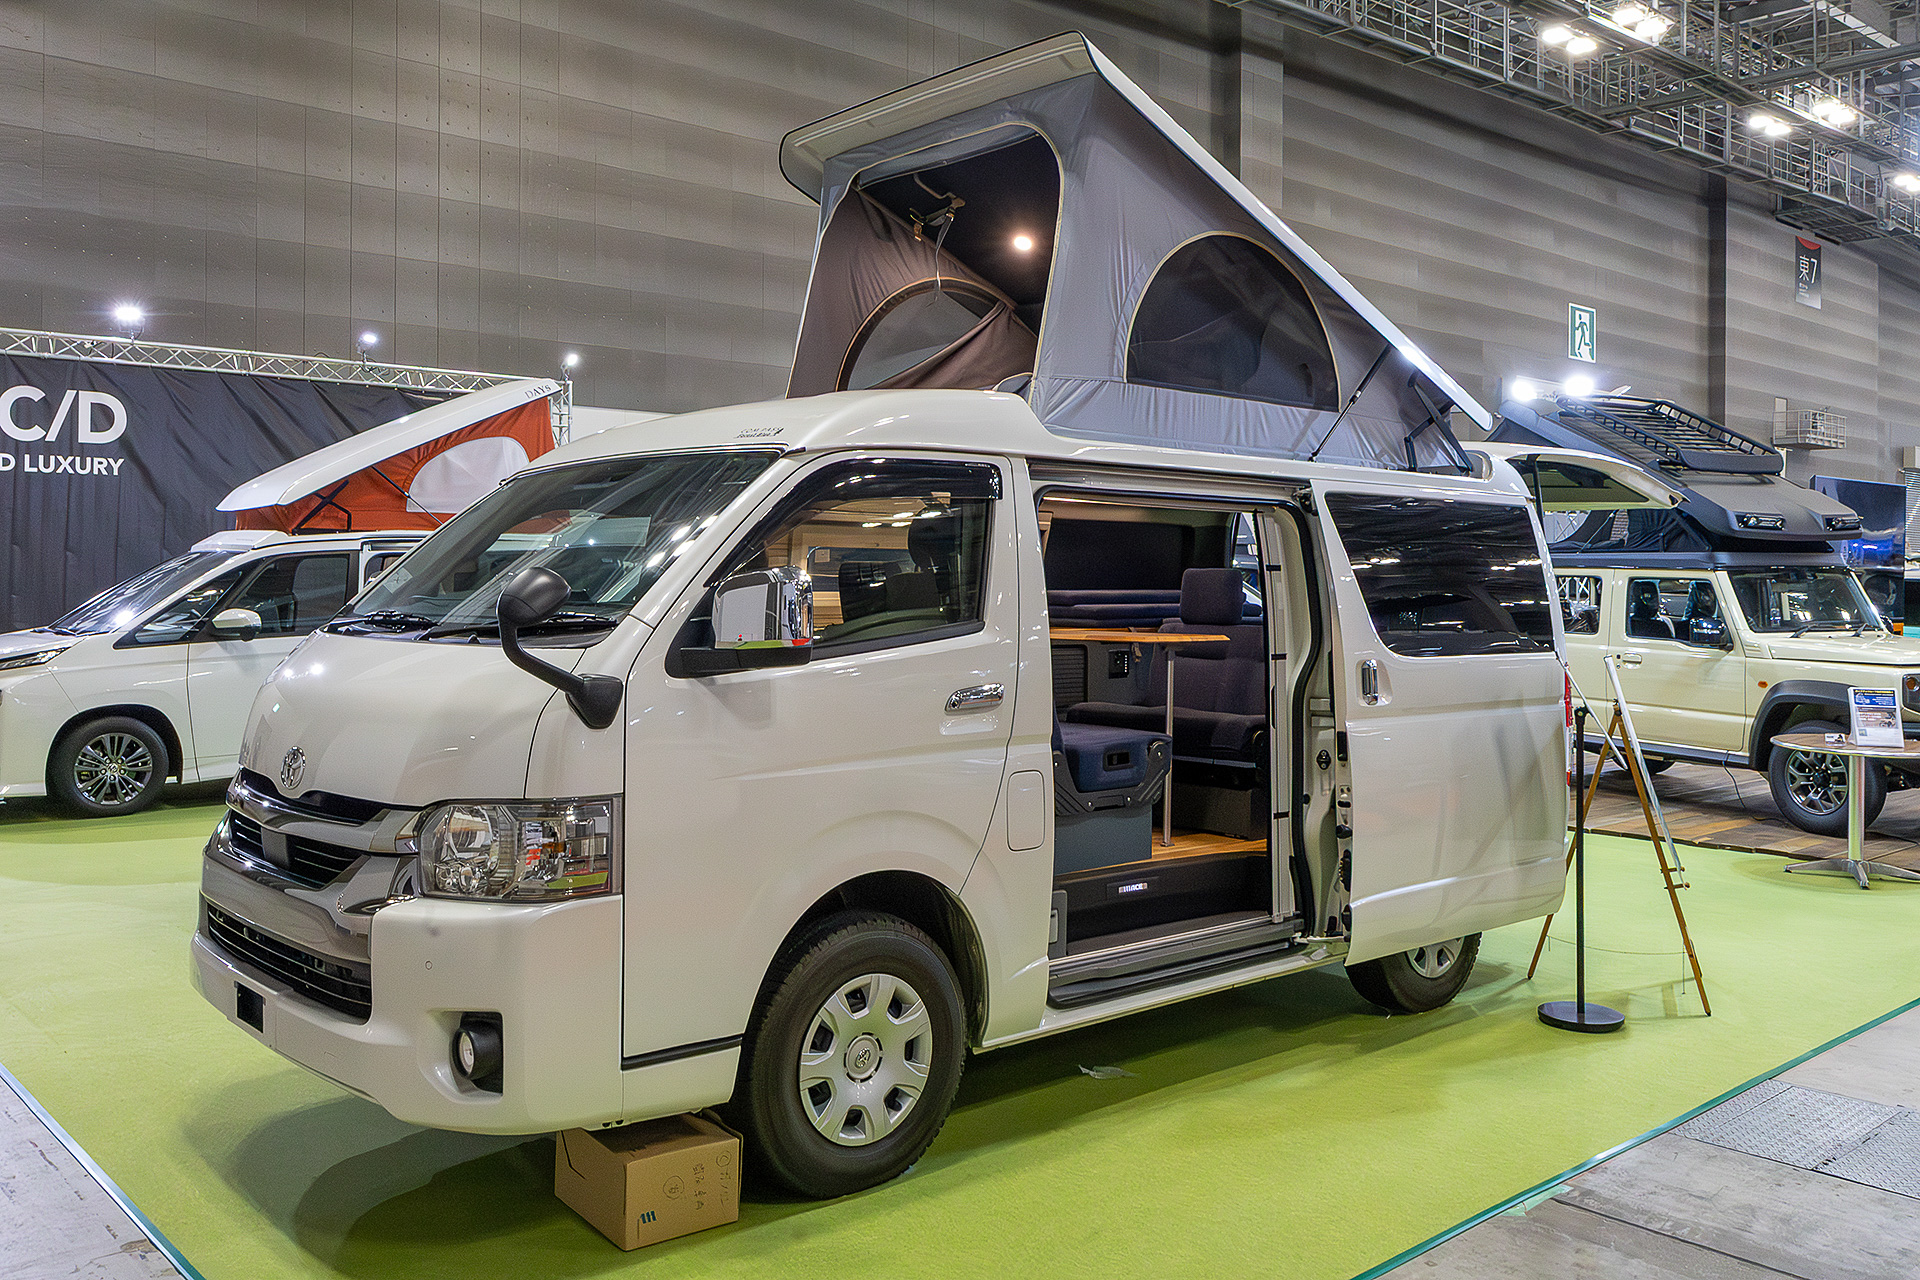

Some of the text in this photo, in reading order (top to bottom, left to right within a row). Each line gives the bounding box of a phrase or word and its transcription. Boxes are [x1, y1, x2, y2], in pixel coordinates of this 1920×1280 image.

[524, 384, 552, 399] DAYS
[0, 385, 128, 444] C/D
[24, 454, 125, 476] LUXURY
